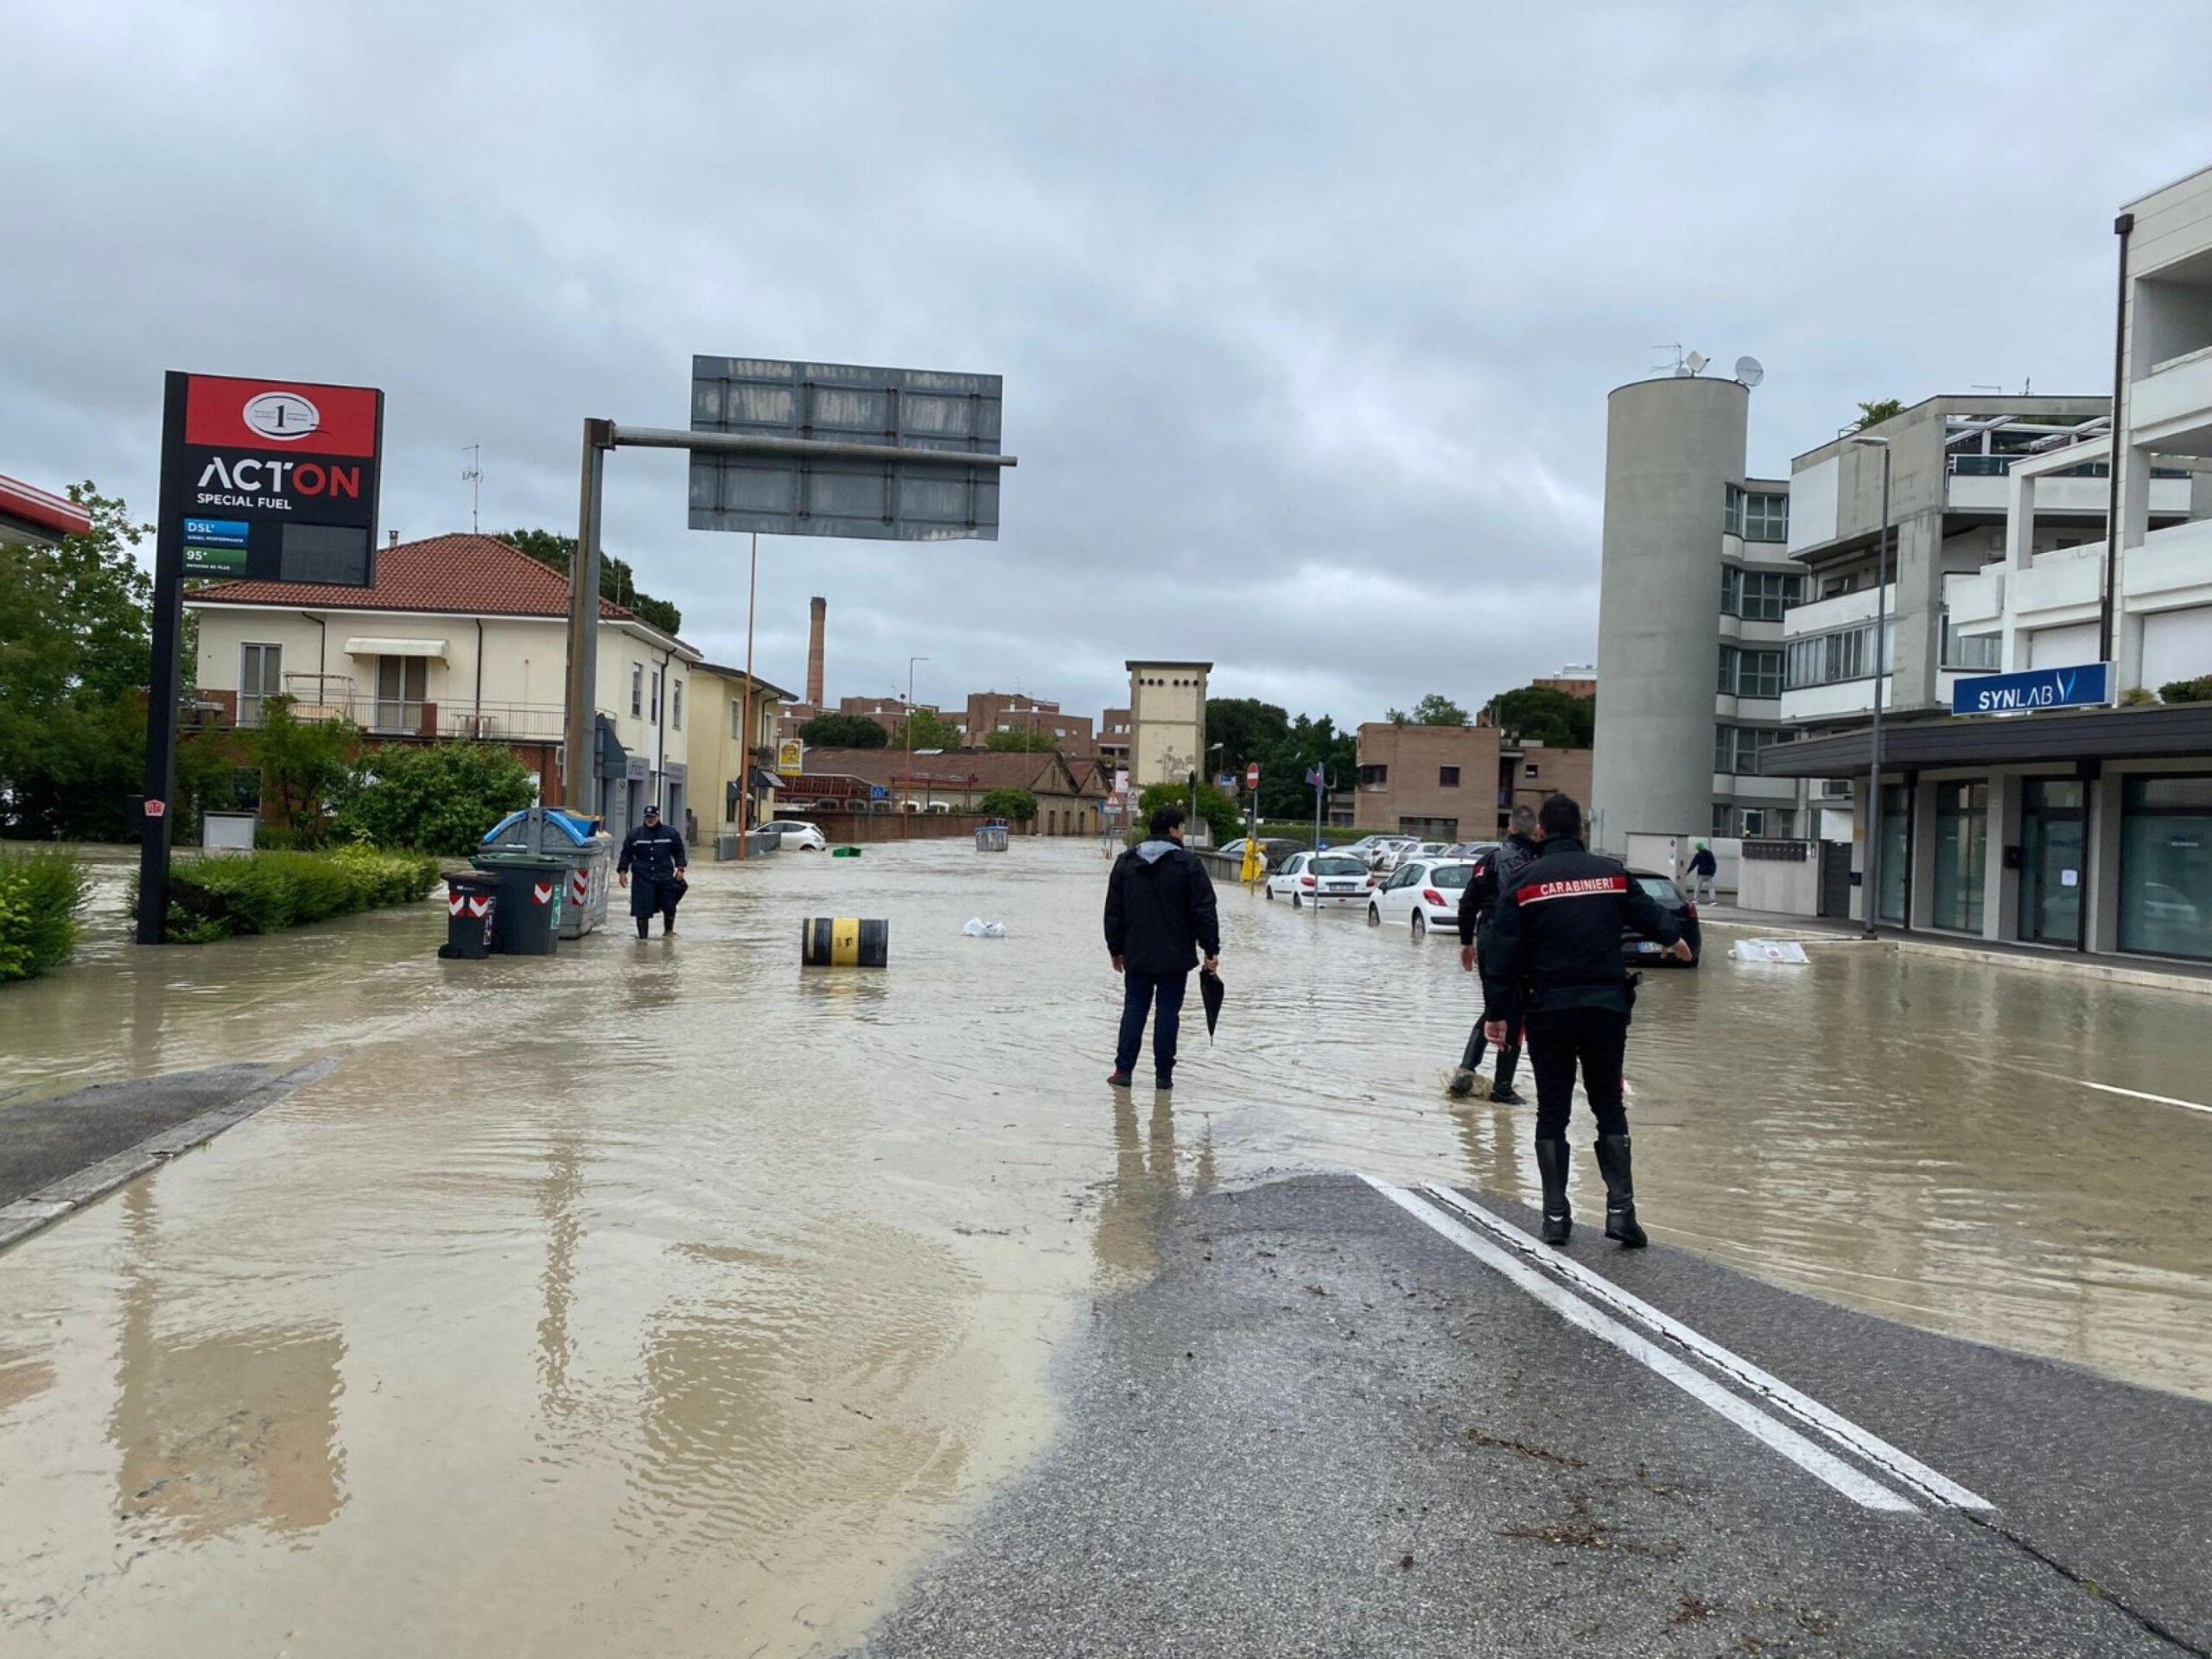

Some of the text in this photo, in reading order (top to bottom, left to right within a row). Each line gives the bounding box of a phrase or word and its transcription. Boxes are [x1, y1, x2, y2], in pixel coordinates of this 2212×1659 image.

[275, 404, 286, 429] 1
[197, 456, 360, 499] ACTON
[196, 493, 293, 511] SPECIAL FUEL
[1978, 685, 2053, 710] SYNLAB
[1540, 877, 1615, 896] CARABINIERI
